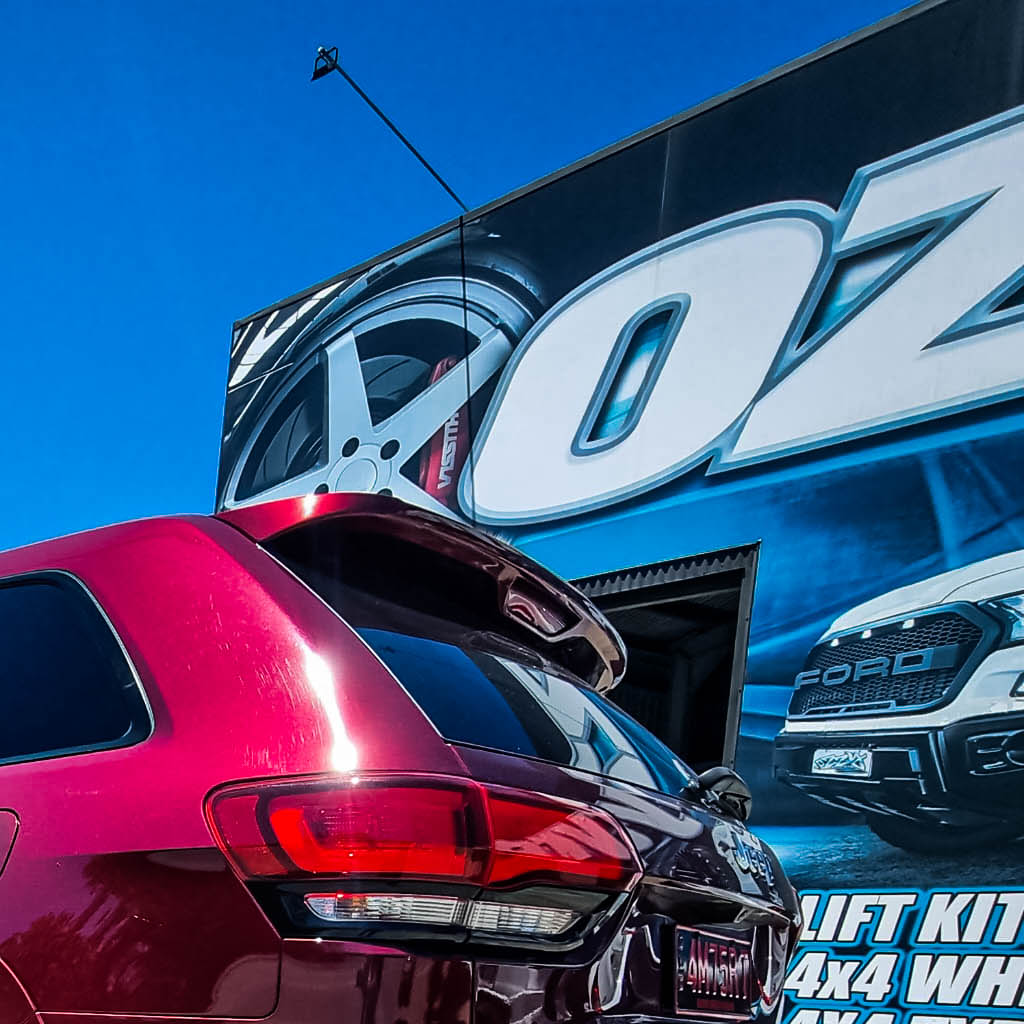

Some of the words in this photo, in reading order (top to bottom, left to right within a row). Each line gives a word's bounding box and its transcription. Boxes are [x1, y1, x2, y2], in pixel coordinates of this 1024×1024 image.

[459, 106, 1024, 525] OZ
[794, 647, 934, 689] FORD
[799, 893, 918, 942] LIFT
[917, 893, 1024, 943] KIT
[783, 952, 899, 1001] 4x4
[906, 954, 1024, 1007] WH
